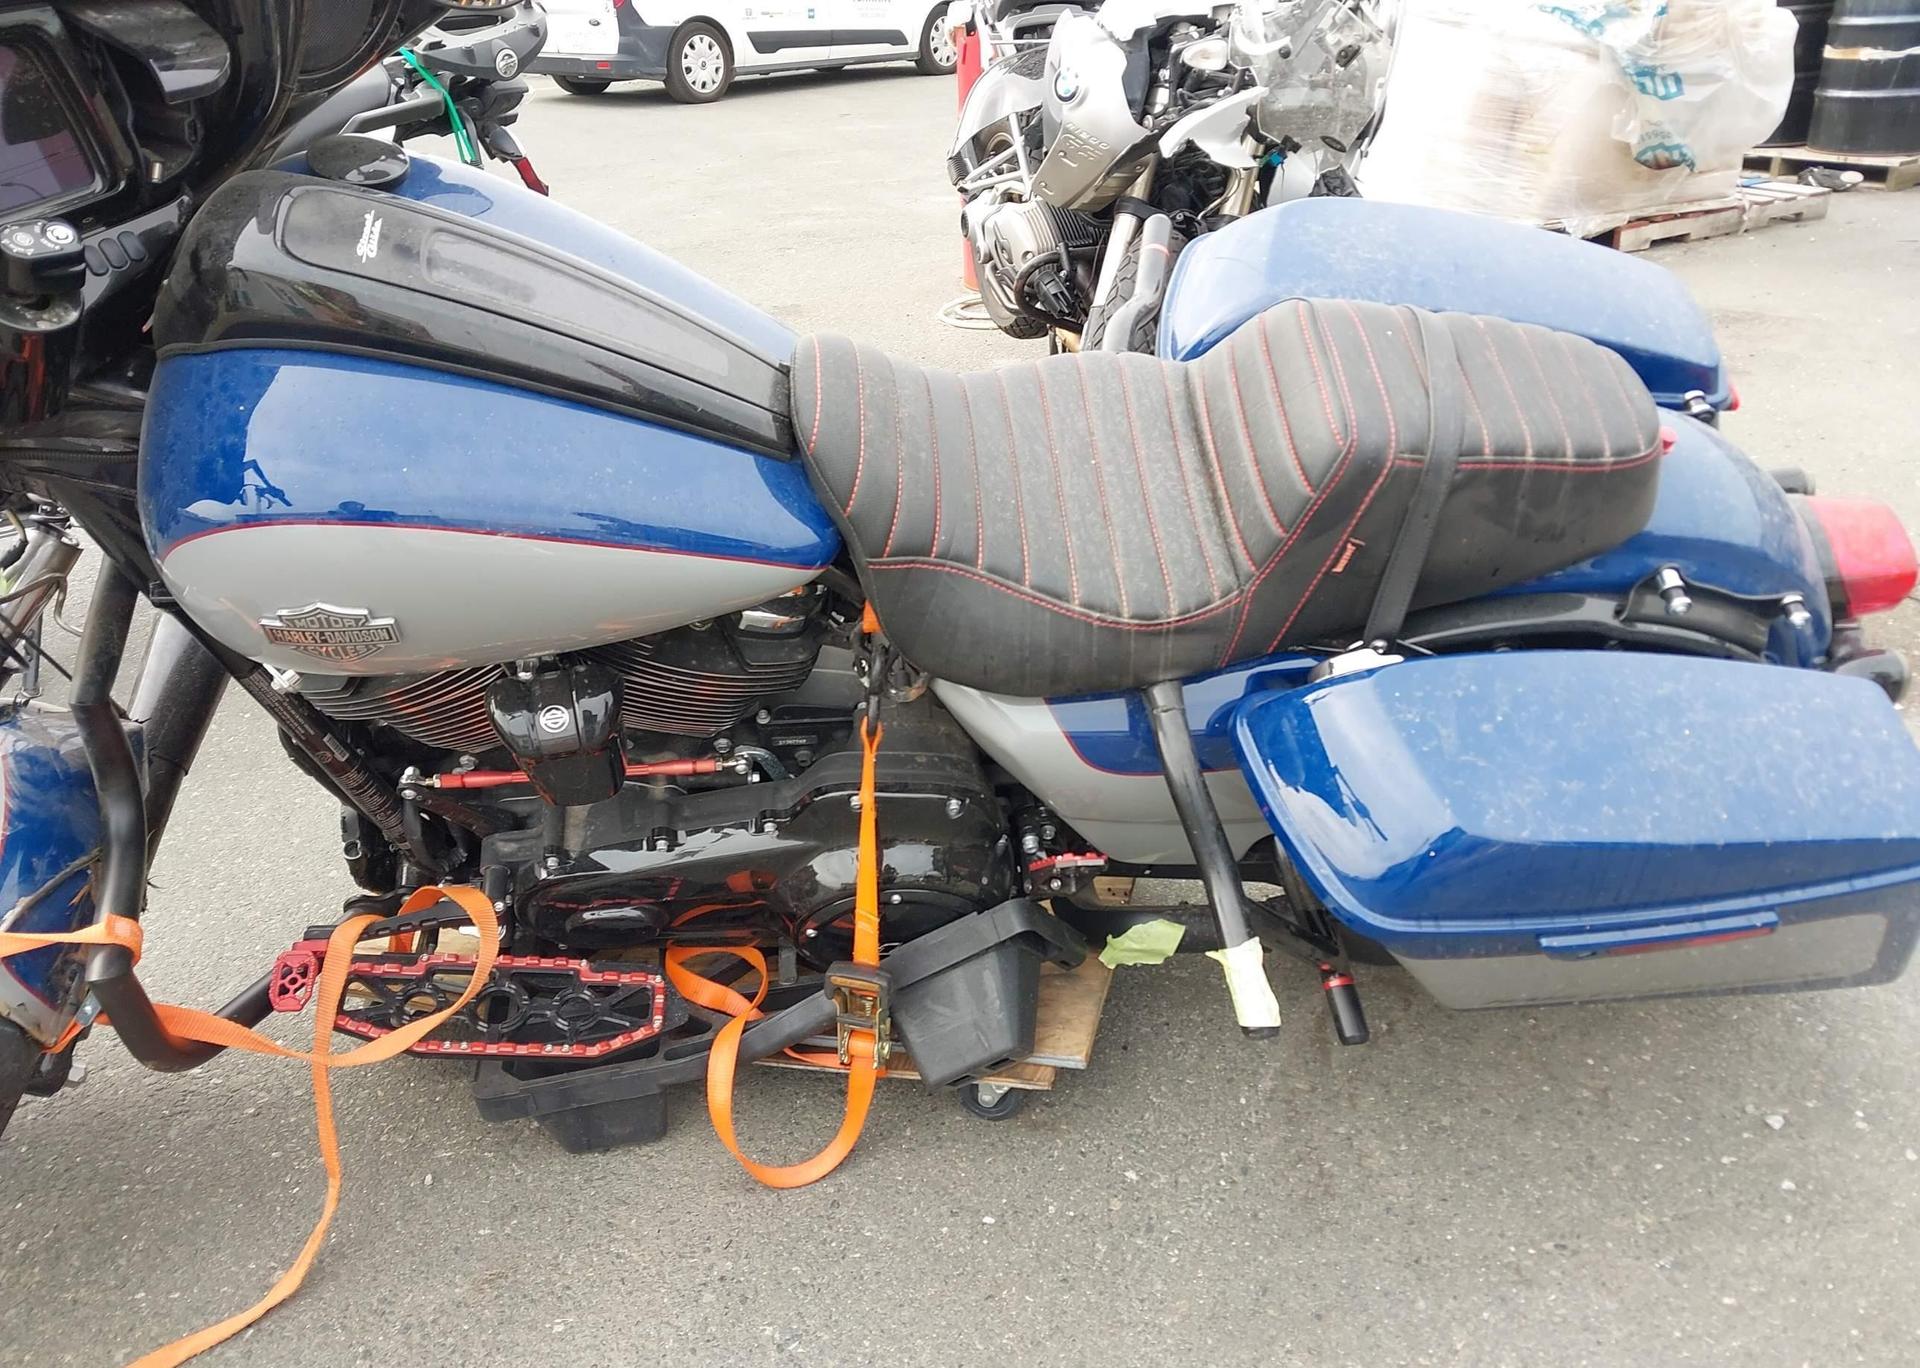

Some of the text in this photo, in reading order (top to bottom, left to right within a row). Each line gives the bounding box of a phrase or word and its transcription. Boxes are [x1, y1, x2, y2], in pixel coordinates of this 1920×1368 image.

[293, 613, 358, 629] MOTOR
[272, 628, 390, 644] HARLEY-DAVIDSON
[306, 645, 367, 660] CYCLES
